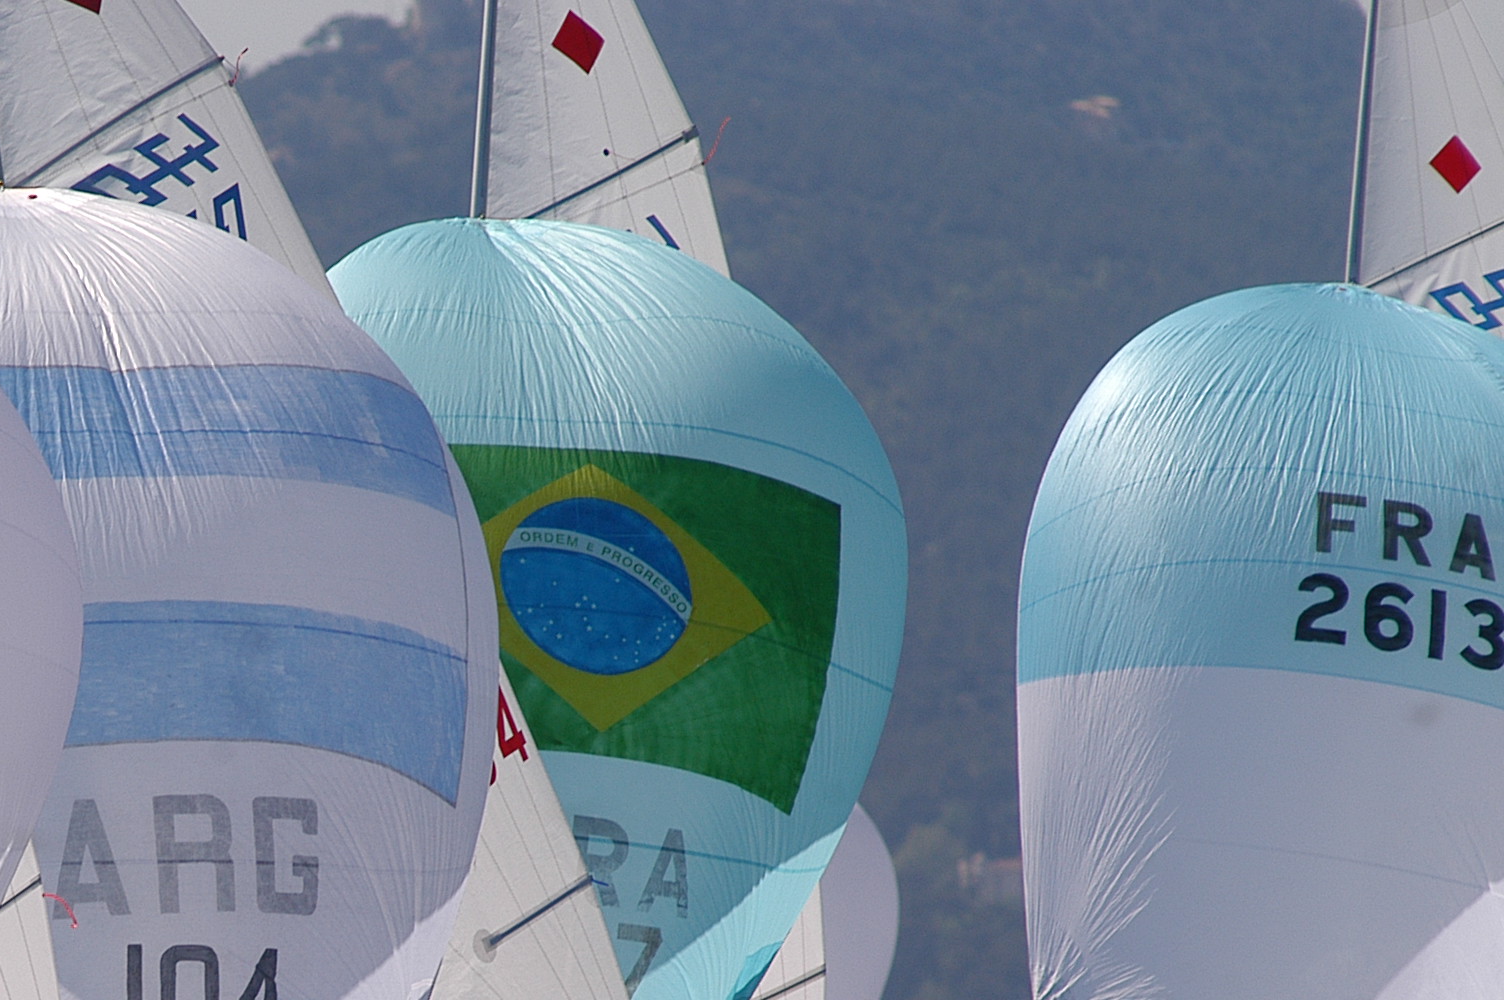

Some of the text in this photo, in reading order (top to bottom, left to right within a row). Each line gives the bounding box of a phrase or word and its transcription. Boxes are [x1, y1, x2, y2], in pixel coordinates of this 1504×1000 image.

[519, 531, 688, 615] ORDEM E PROGRESSO
[1315, 491, 1497, 581] FRA
[1294, 573, 1504, 671] 2613
[52, 793, 319, 921] ARG
